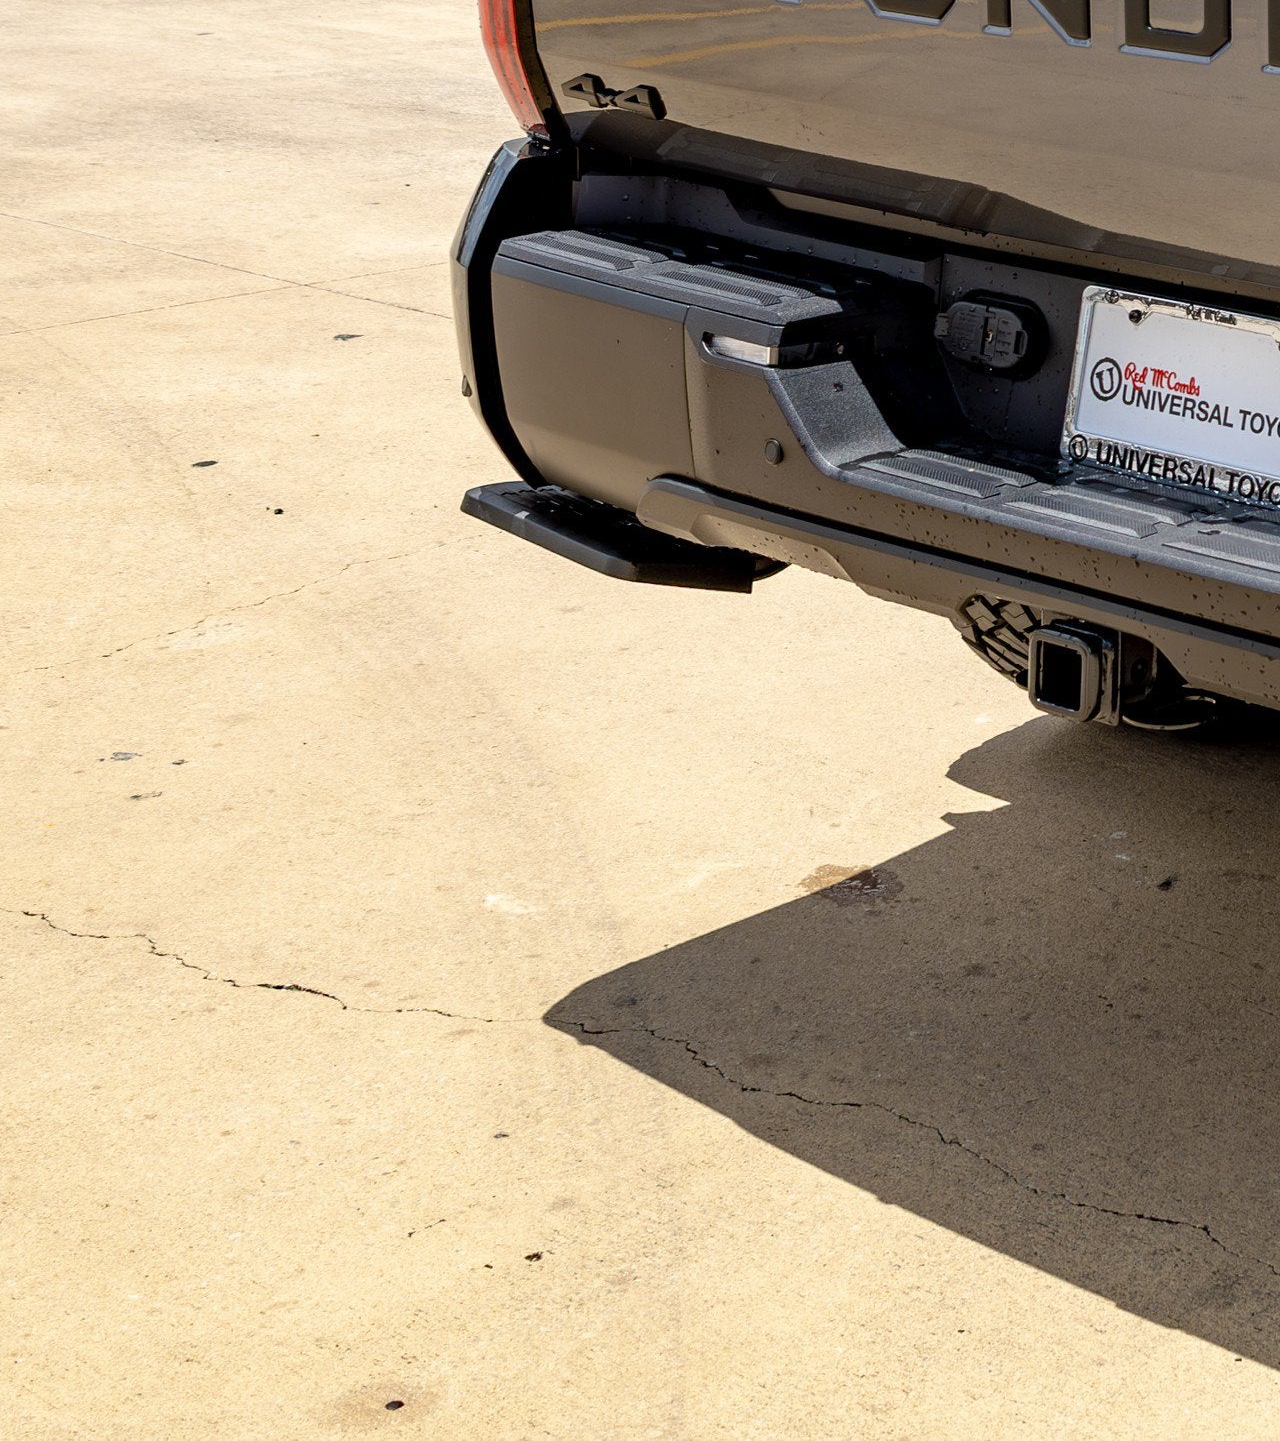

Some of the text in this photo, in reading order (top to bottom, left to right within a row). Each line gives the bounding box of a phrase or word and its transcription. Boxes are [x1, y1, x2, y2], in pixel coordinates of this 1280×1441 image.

[1124, 362, 1200, 396] Red McCombs
[1122, 384, 1234, 428] UNIVERSAL
[1096, 442, 1217, 493] UNIVERSAL
